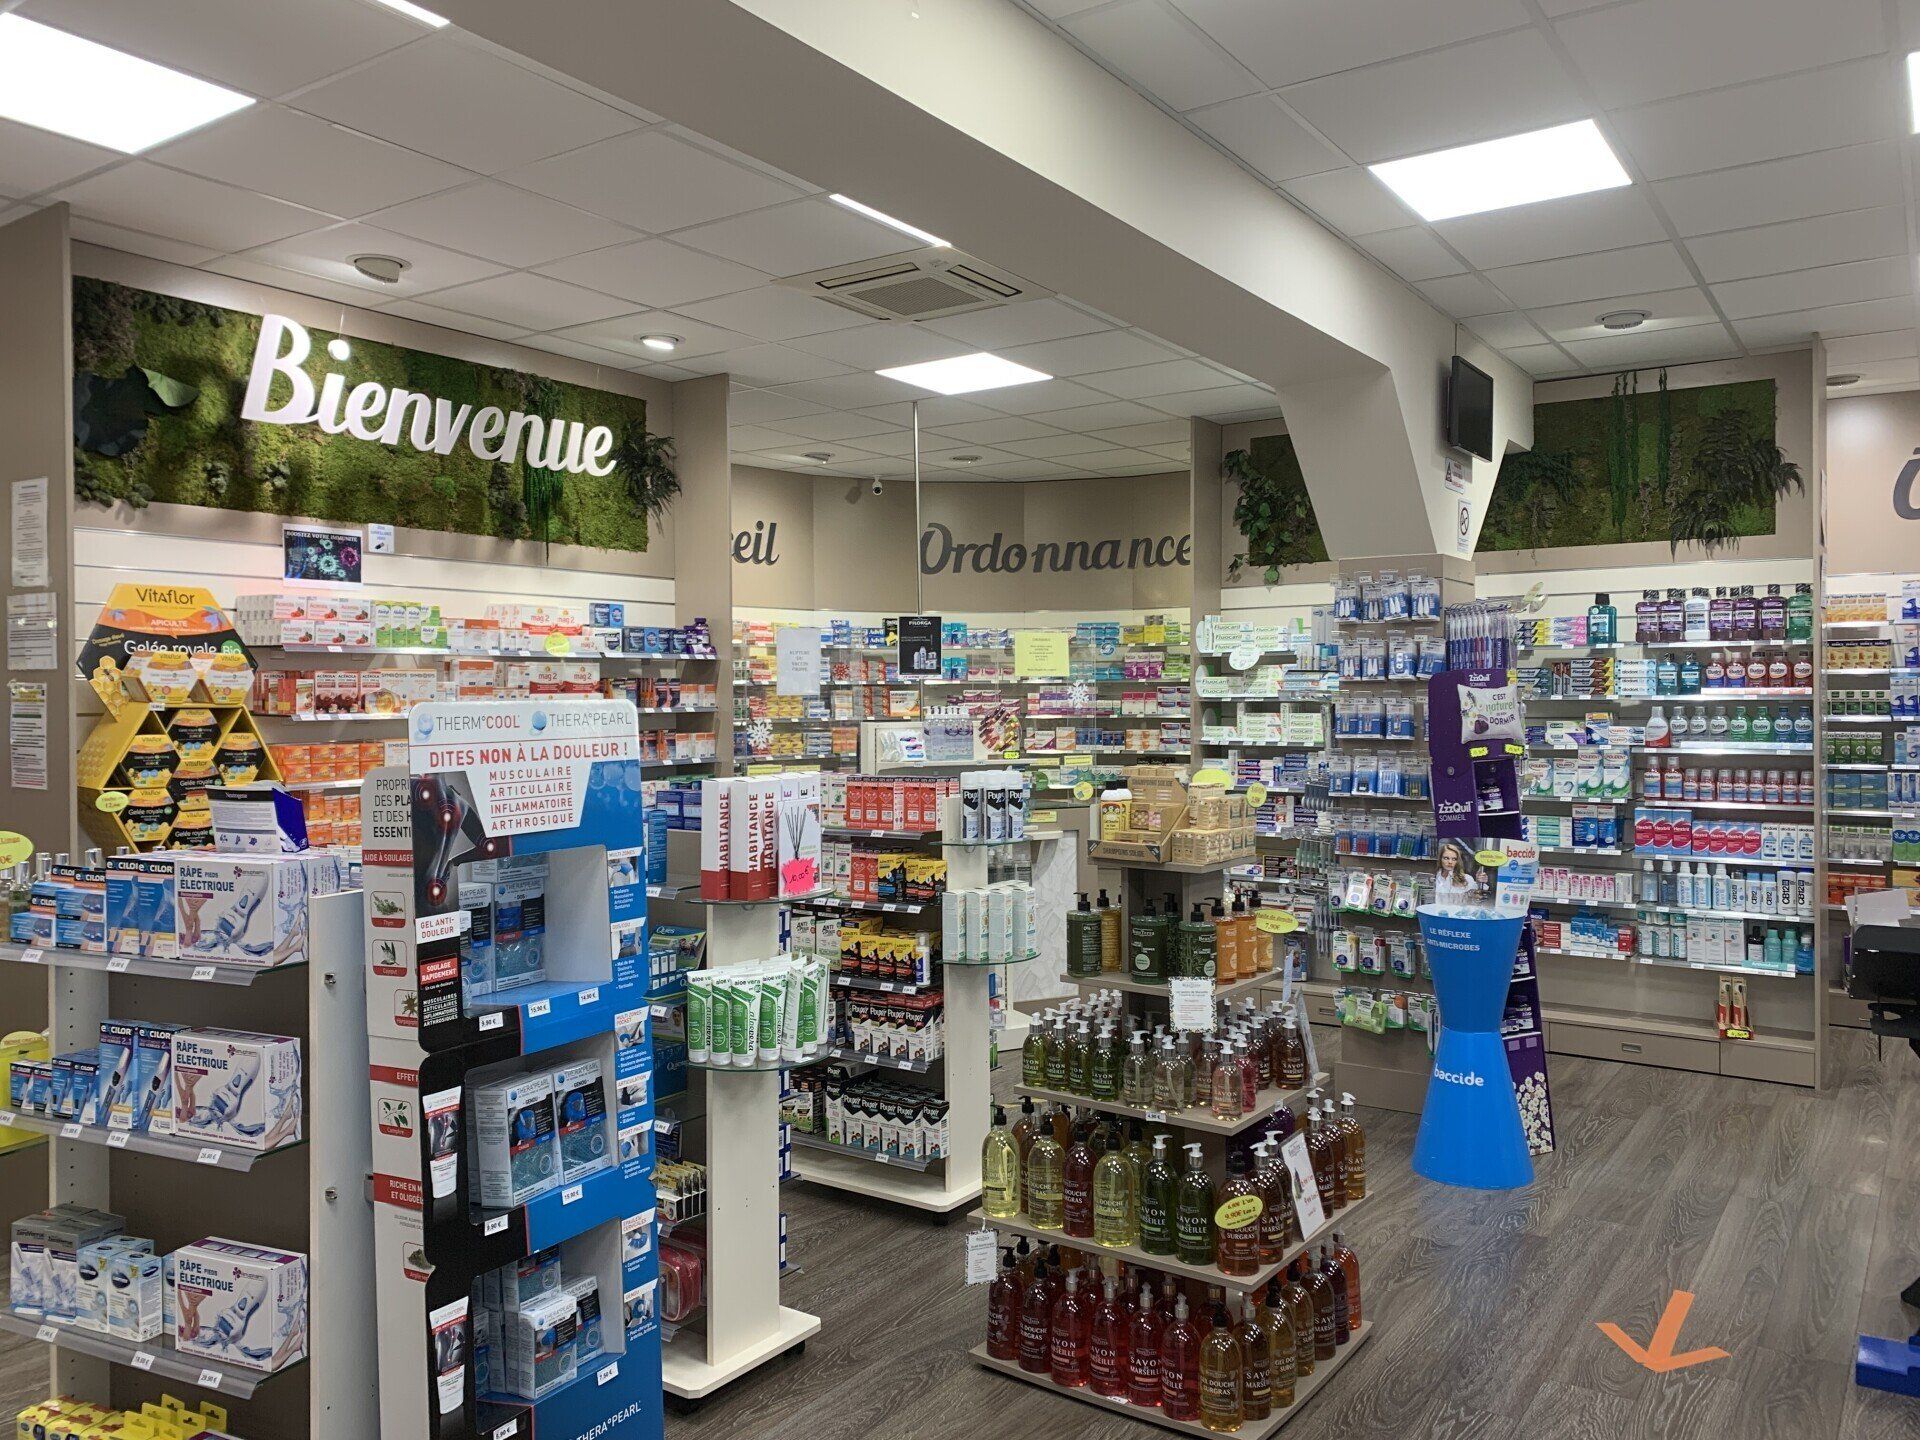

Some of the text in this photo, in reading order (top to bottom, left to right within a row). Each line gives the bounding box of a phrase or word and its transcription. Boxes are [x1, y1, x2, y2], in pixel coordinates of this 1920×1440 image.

[241, 314, 617, 477] Bienvenue
[731, 521, 780, 566] eil
[921, 523, 1191, 574] Ordonnance
[136, 587, 194, 605] Vitaflor
[531, 615, 544, 623] mag
[124, 640, 167, 655] Gelée
[172, 644, 216, 654] royale
[222, 644, 241, 654] Bio
[1469, 673, 1491, 682] ZzzQuil
[1485, 701, 1515, 713] naturel
[437, 716, 518, 731] THERM°COOL
[550, 712, 632, 726] THERA°PEARL
[1490, 714, 1516, 725] DORMIR
[430, 743, 628, 767] DITES NON À LA DOULEUR !
[490, 766, 571, 781] MUSCULAIRE
[376, 780, 410, 790] PROPRI
[490, 782, 572, 798] ARTICULAIRE
[374, 794, 411, 806] DES PLA
[491, 798, 573, 814] INFLAMMATOIRE
[1438, 800, 1473, 814] ZzzQuil
[373, 811, 384, 821] ET
[387, 811, 404, 821] DES
[492, 814, 574, 831] ARTHROSIQUE
[374, 827, 412, 838] ESSENTI
[720, 792, 729, 870] HABITANCE
[749, 794, 758, 871] HABITANCE
[764, 792, 774, 868] HABITANCE
[364, 852, 414, 862] AIDE À SOULAGER
[1506, 846, 1535, 860] baccide
[180, 866, 202, 878] RÂPE
[180, 878, 234, 892] ÉLECTRIQUE
[436, 917, 454, 927] ANTI-
[422, 926, 454, 938] DOULEUR
[1438, 928, 1471, 939] RÉFLEXE
[1427, 939, 1480, 951] ANTI-MICROBES
[427, 962, 451, 972] SOULAGE
[422, 969, 457, 982] RAPIDEMENT
[423, 993, 457, 1005] MUSCULAIRES
[424, 1000, 457, 1012] ARTICULAIRES
[424, 1008, 458, 1019] INFLAMMATOIRES
[424, 1014, 458, 1027] ARTHROSIQUES
[176, 1042, 197, 1054] RÂPE
[176, 1053, 228, 1070] ÉLECTRIQUE
[397, 1072, 416, 1081] EFFET
[1434, 1063, 1484, 1087] baccide
[1319, 1173, 1334, 1183] SAV
[390, 1180, 407, 1189] RICHE
[400, 1192, 423, 1204] OLIGOÉL
[1141, 1208, 1166, 1217] AVON
[1227, 1231, 1255, 1240] SURGRAS
[180, 1260, 202, 1273] RÂPE
[180, 1272, 234, 1292] ÉLECTRIQUE
[576, 1401, 642, 1440] THERA°PEARL
